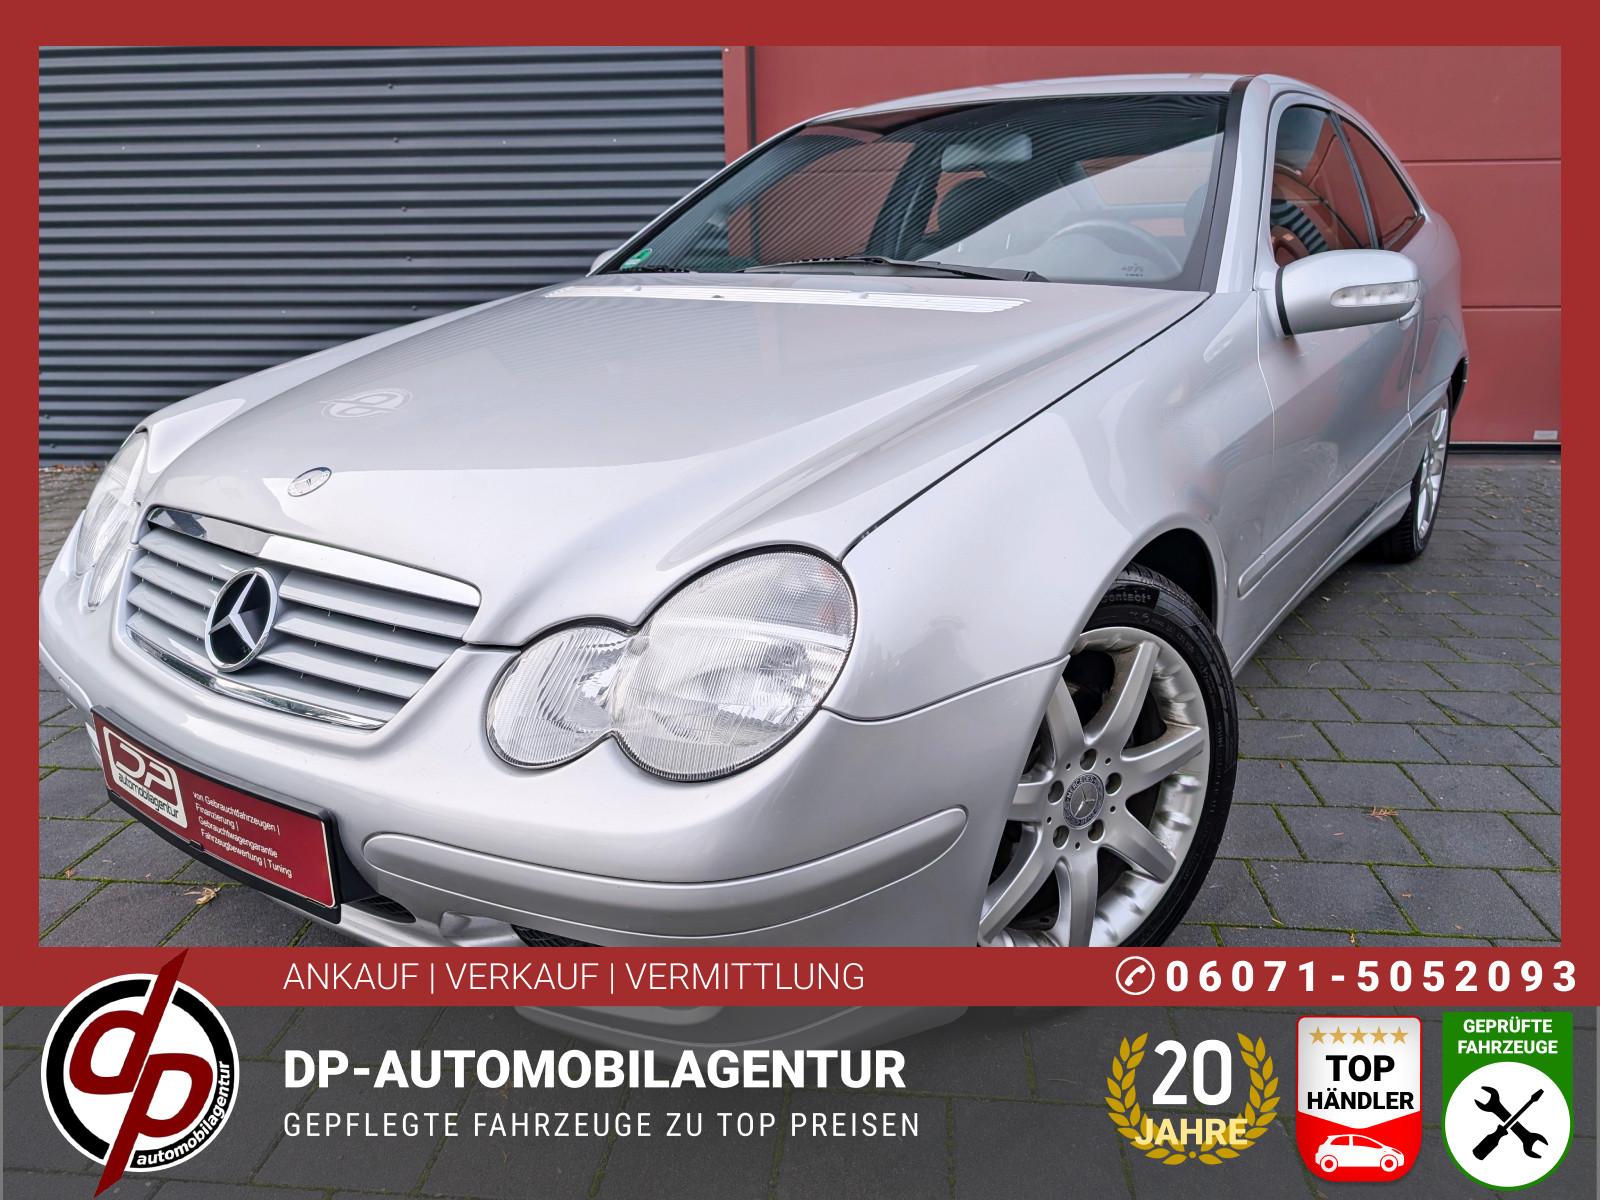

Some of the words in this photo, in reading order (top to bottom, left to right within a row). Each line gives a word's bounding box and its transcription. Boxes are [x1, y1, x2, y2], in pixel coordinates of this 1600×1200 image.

[116, 743, 173, 790] DP
[118, 773, 179, 818] automobilagentur
[193, 791, 204, 802] von
[204, 795, 276, 831] Gebrauchtfahrzeugen
[195, 803, 235, 830] Finanzierung
[199, 816, 278, 858] Gebrauchtwagengarantie
[201, 828, 263, 866] Fahrzeugbewertung
[267, 859, 293, 879] Tuning
